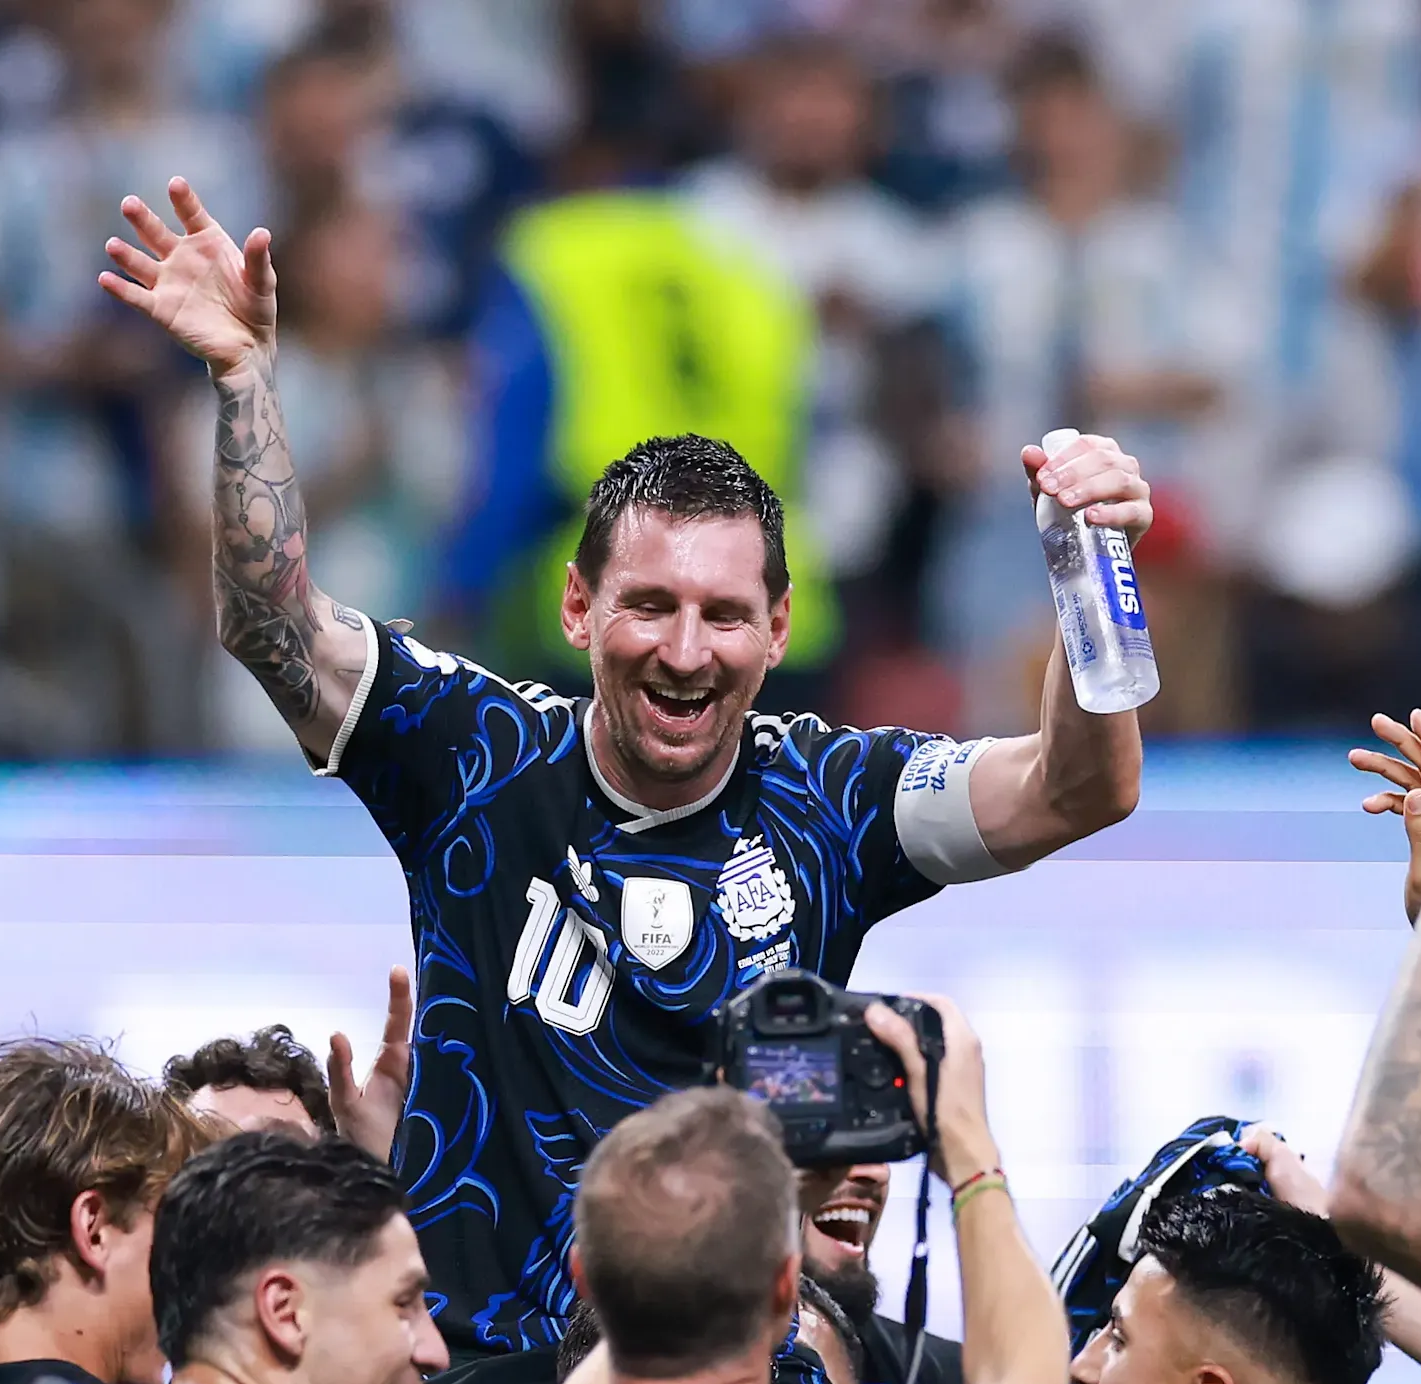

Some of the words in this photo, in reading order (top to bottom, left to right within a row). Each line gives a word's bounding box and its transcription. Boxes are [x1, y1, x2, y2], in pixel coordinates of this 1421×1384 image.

[734, 872, 776, 913] AFA
[641, 933, 672, 945] FIFA
[507, 876, 616, 1036] 10
[646, 949, 665, 957] 2022
